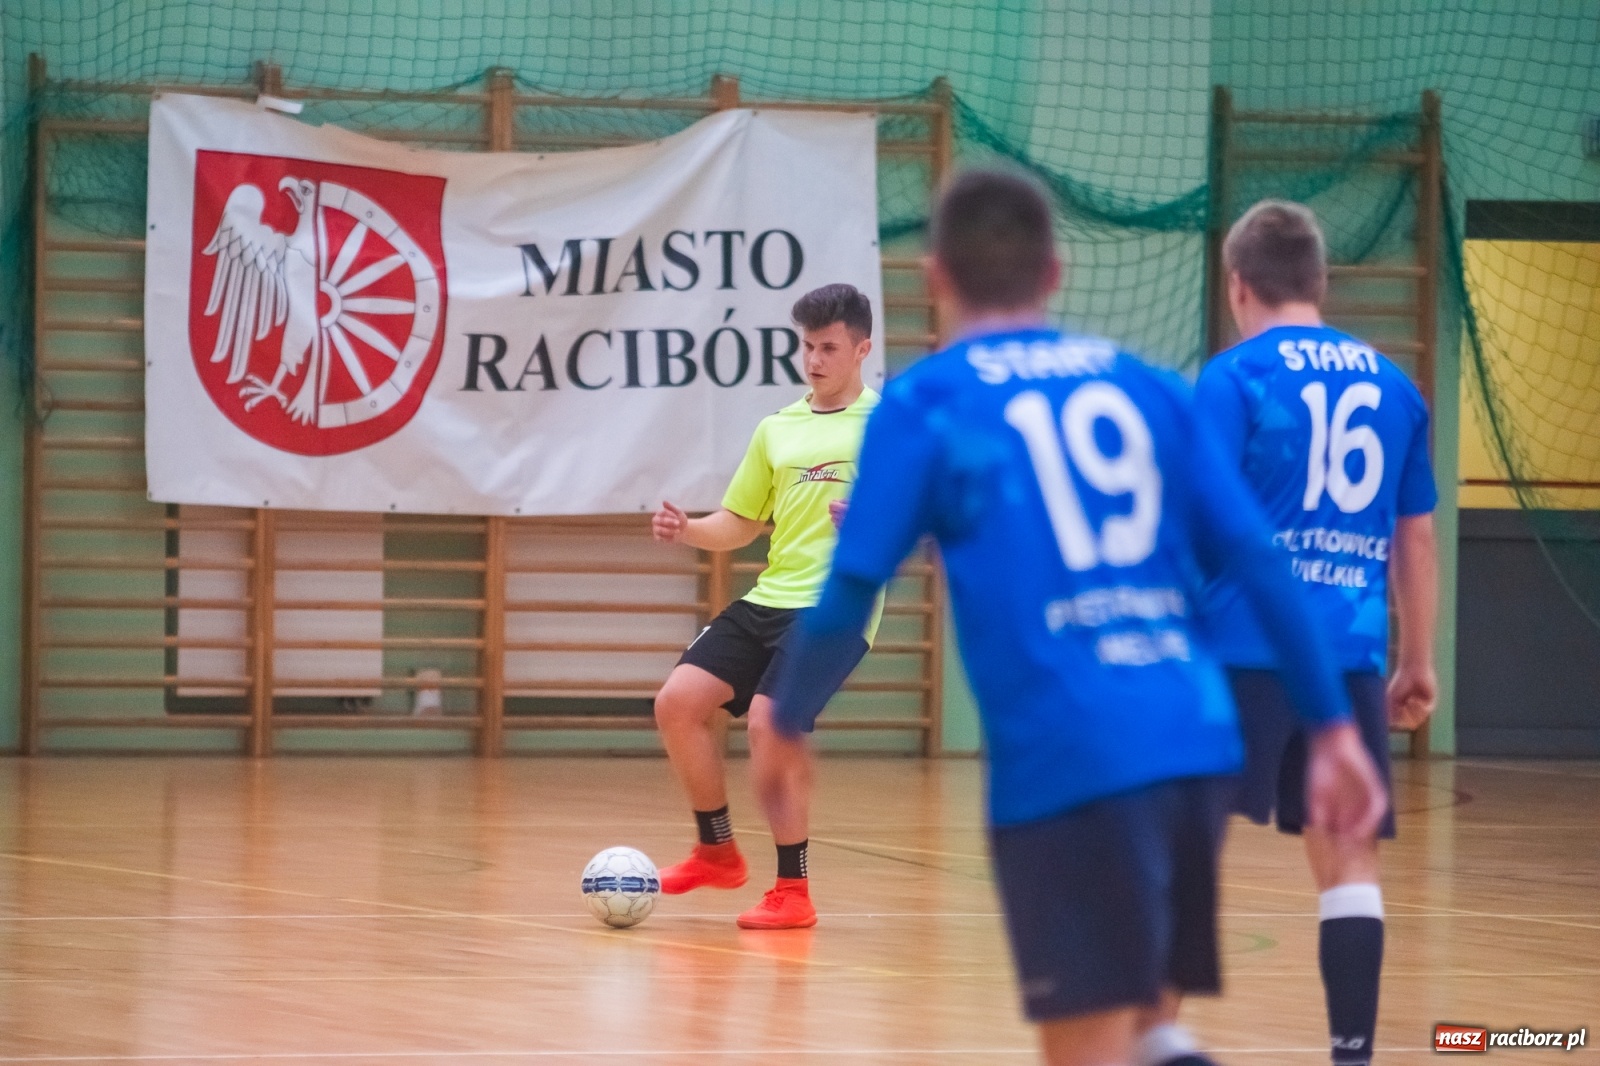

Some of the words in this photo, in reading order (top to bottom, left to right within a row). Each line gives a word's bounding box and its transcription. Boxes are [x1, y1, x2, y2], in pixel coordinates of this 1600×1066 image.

[515, 229, 805, 297] MIASTO
[458, 308, 809, 392] RACIBÓR
[1278, 339, 1380, 374] START
[1003, 380, 1163, 572] 19
[1300, 381, 1384, 514] 16
